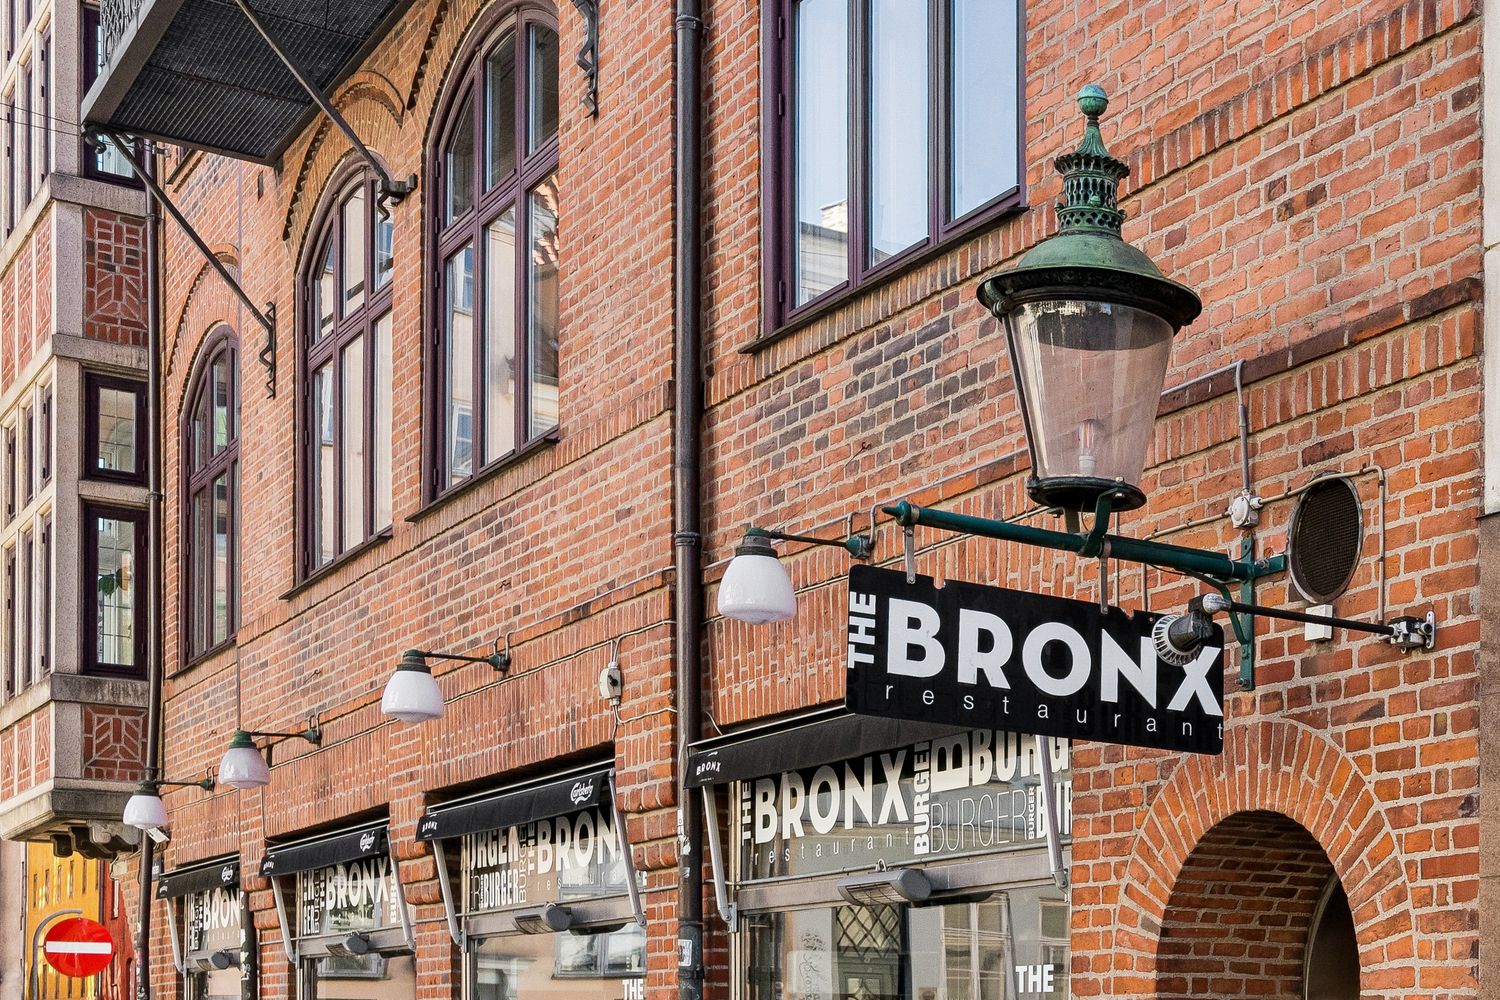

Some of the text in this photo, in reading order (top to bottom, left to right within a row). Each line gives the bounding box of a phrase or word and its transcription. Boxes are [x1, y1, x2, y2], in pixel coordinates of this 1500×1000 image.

[847, 590, 1224, 717] THE BRONX
[885, 682, 1224, 740] restaurant
[695, 761, 721, 776] BRONX
[741, 747, 909, 847] THE BRONX
[930, 789, 1028, 853] BURGER
[1028, 785, 1036, 840] BURGER
[537, 805, 622, 875] BRON
[753, 827, 909, 866] restaurant
[203, 887, 241, 931] BRON
[325, 856, 389, 911] BRONX
[483, 868, 519, 909] BURGER
[622, 978, 644, 1000] THE
[1015, 964, 1055, 993] THE
